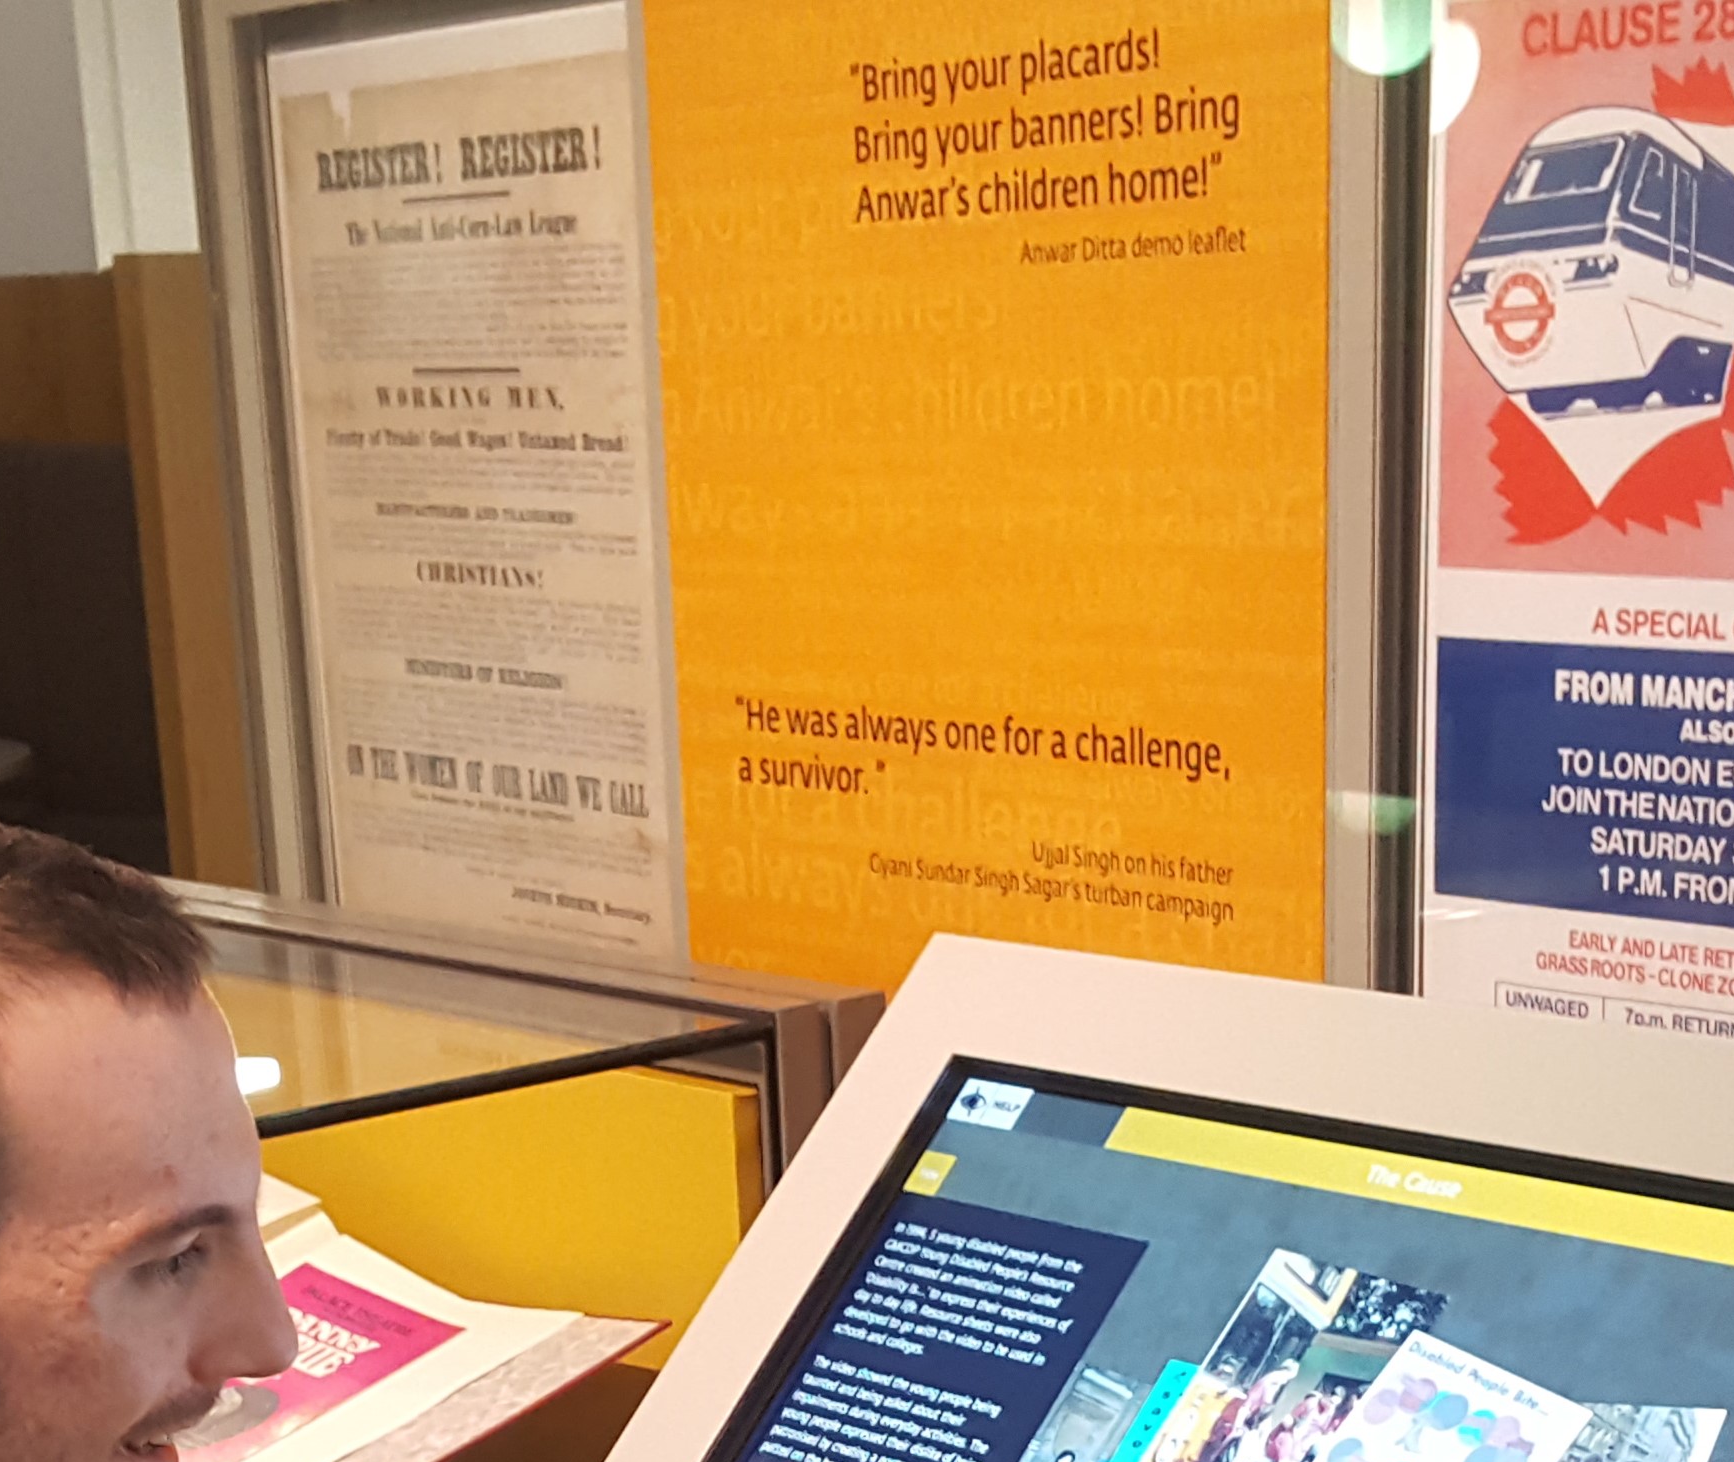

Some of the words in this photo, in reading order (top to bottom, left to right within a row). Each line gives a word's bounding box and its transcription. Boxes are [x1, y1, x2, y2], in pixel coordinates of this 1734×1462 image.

[1522, 1, 1681, 57] CLAUSE
[849, 57, 937, 108] "Bring
[943, 53, 1012, 105] your
[1020, 26, 1160, 97] placards!
[853, 119, 928, 170] Bring
[934, 119, 1003, 169] your
[1010, 94, 1144, 150] banners!
[1154, 85, 1240, 141] Bring
[315, 140, 443, 193] REGISTER!
[458, 124, 601, 183] REGISTER!
[855, 175, 970, 224] Anwar's
[977, 167, 1099, 216] children
[1107, 150, 1222, 205] home!"
[1020, 240, 1078, 265] Anwar
[1081, 235, 1127, 263] Ditta
[1131, 232, 1184, 259] demo
[1187, 226, 1247, 256] leaflet
[375, 386, 491, 409] WORKING
[507, 385, 565, 411] MEN,
[1591, 607, 1610, 635] A
[1614, 608, 1727, 642] SPECIAL
[1554, 668, 1634, 706] FROM
[734, 695, 781, 734] "He
[785, 707, 838, 740] was
[844, 704, 938, 755] always
[944, 720, 996, 754] one
[1002, 714, 1044, 757] for
[1050, 729, 1068, 760] a
[1075, 722, 1230, 784] challenge,
[738, 755, 754, 784] a
[759, 753, 869, 795] survivor.
[1557, 747, 1594, 778] TO
[1598, 750, 1711, 787] LONDON
[1541, 784, 1602, 816] JOIN
[1603, 788, 1656, 820] THE
[1071, 844, 1121, 877] Singh
[1124, 854, 1147, 875] on
[1150, 852, 1176, 881] his
[1179, 855, 1235, 886] father
[1590, 825, 1727, 866] SATURDAY
[973, 864, 1020, 897] Singh
[1023, 871, 1082, 903] Sagar's
[1085, 880, 1142, 910] turban
[1145, 893, 1235, 927] campaign
[1599, 864, 1610, 892] 1
[1617, 865, 1668, 898] P.M.
[1568, 929, 1618, 954] EARLY
[1620, 936, 1656, 960] AND
[1659, 941, 1699, 966] LATE
[1535, 950, 1589, 977] GRASS
[1589, 958, 1646, 985] ROOTS
[1657, 966, 1715, 995] CLONE
[1506, 990, 1588, 1019] UNWAGED
[1367, 1164, 1401, 1189] The
[1403, 1171, 1462, 1199] Cause
[813, 1354, 832, 1370] The
